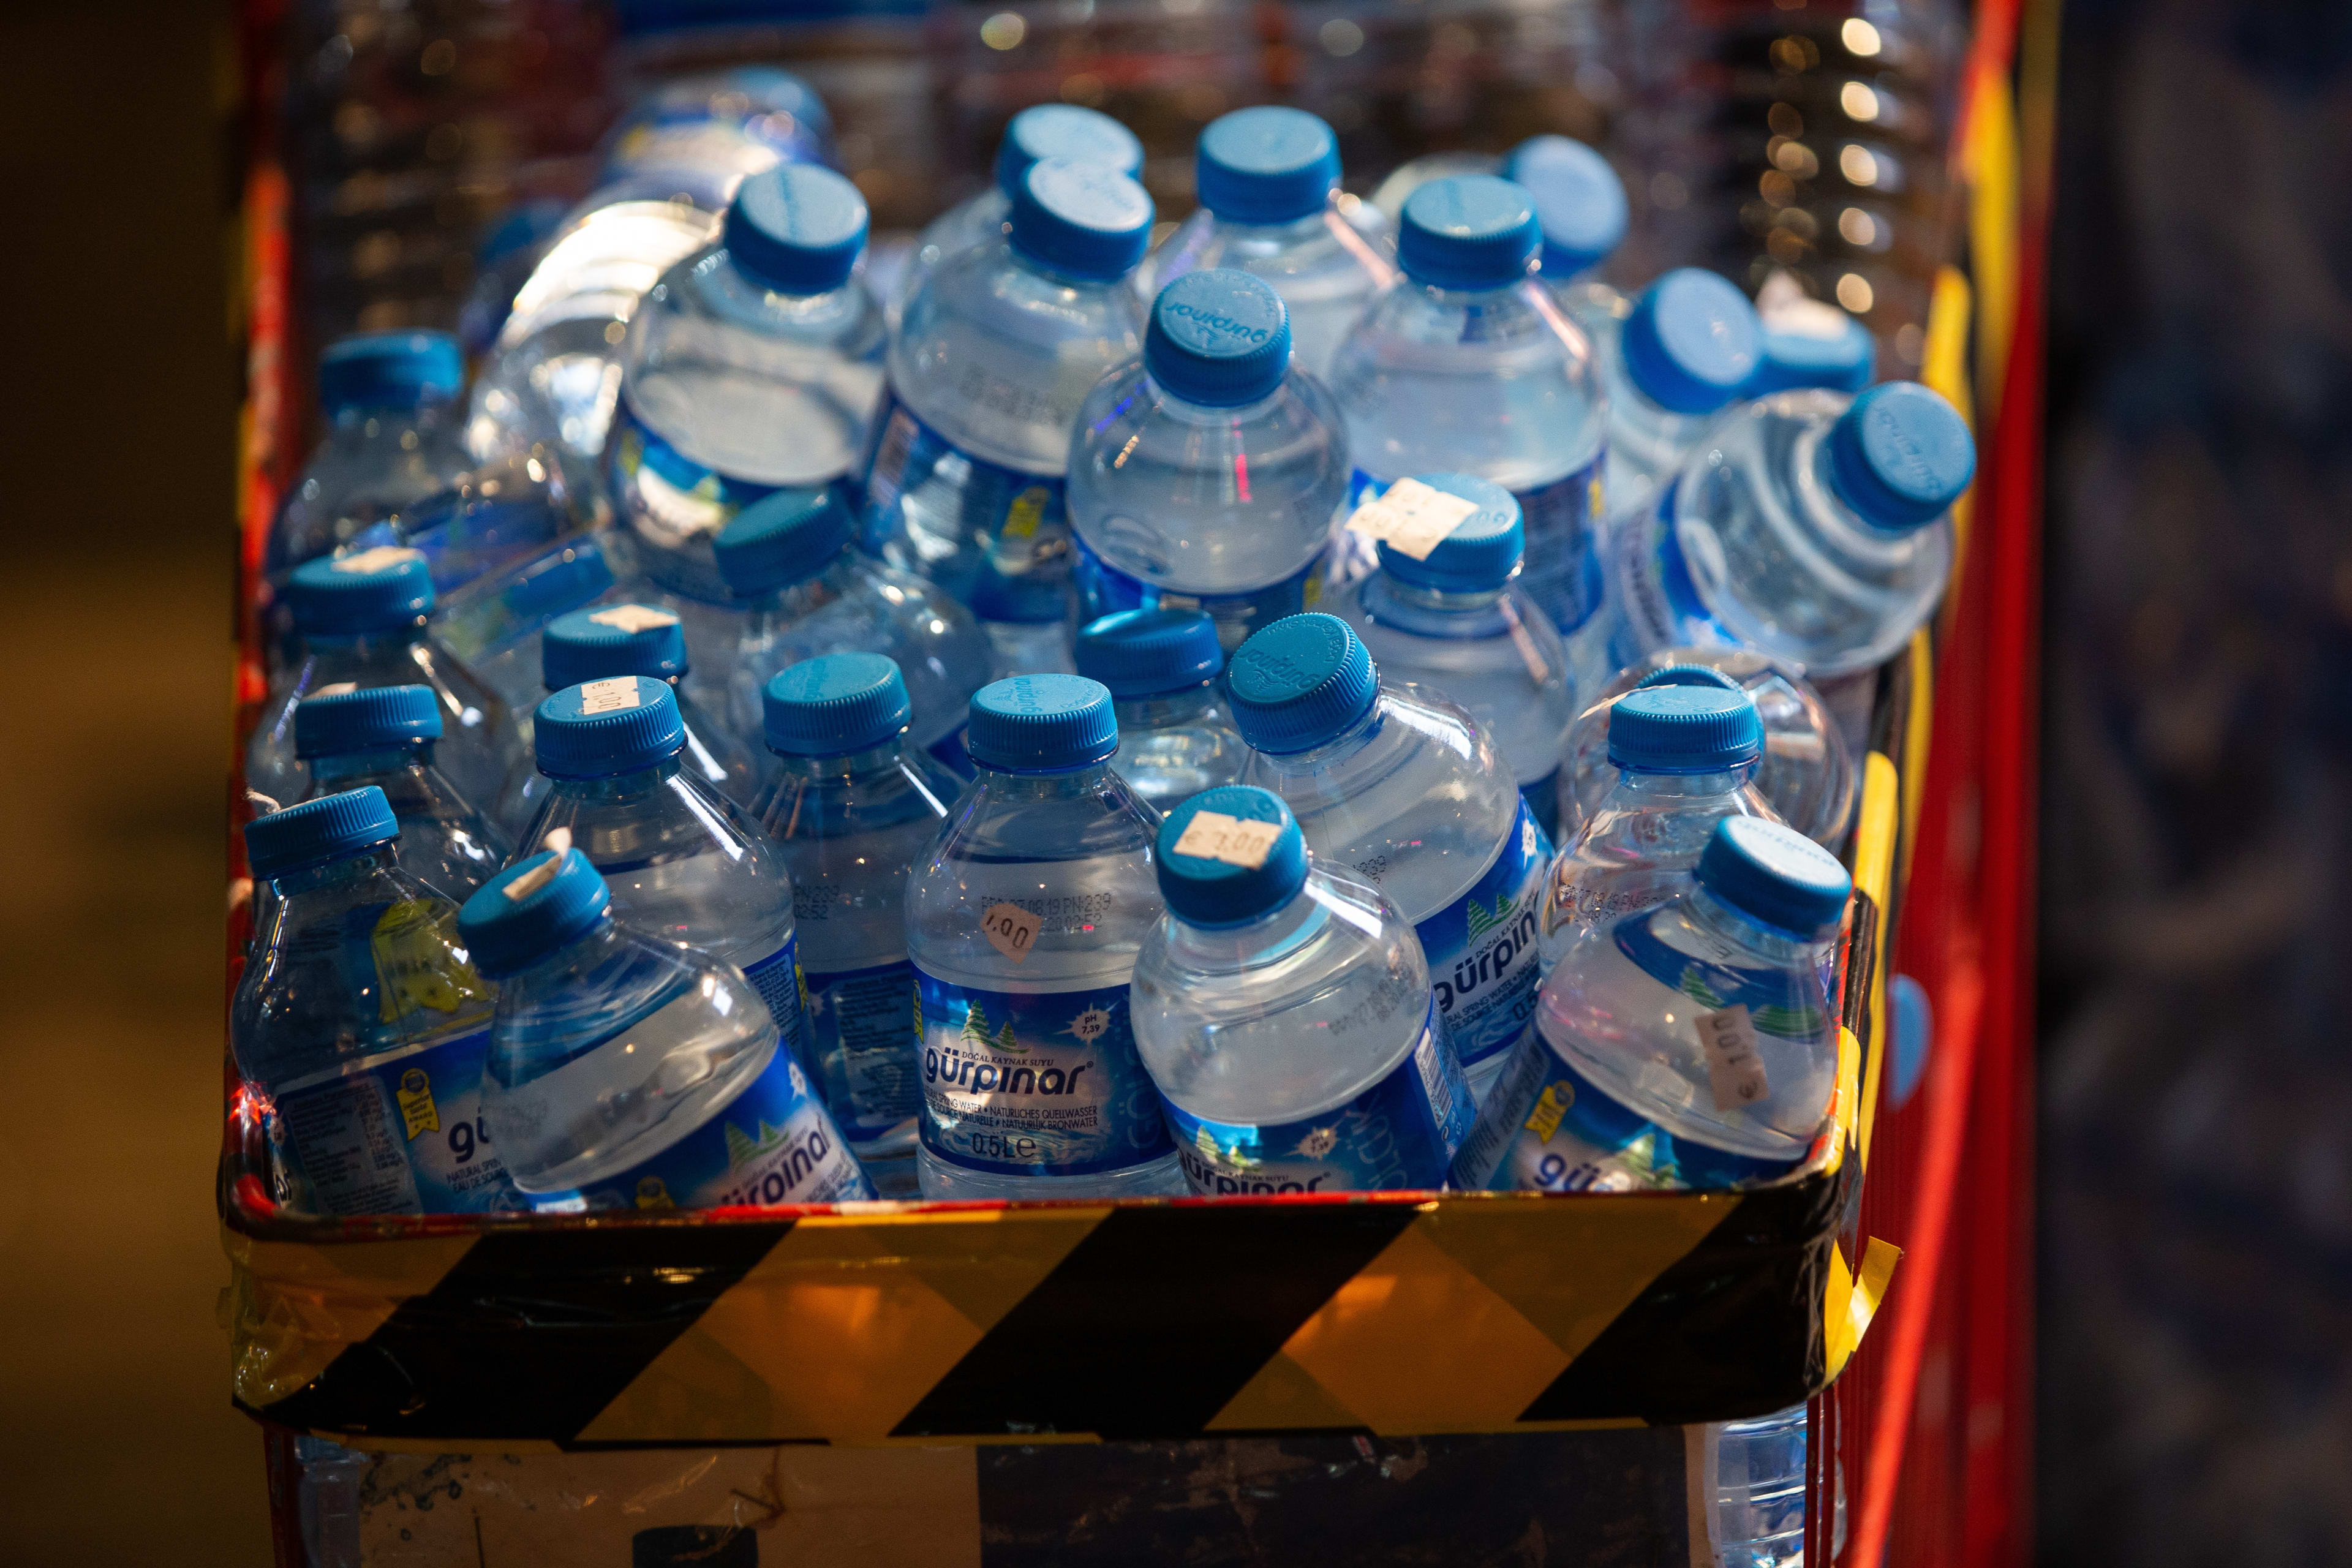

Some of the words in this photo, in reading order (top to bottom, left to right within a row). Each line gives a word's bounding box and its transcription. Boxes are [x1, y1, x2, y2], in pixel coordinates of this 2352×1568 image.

[1085, 1014, 1097, 1025] pH
[1082, 1024, 1100, 1035] 7,39
[962, 1051, 990, 1063] DOĞAL
[990, 1057, 1028, 1066] KAYNAK
[959, 1099, 982, 1114] WATER
[1042, 1105, 1098, 1120] QUELLWASSER
[959, 1112, 994, 1126] NATURELLE
[1048, 1116, 1098, 1130] BRONWATER
